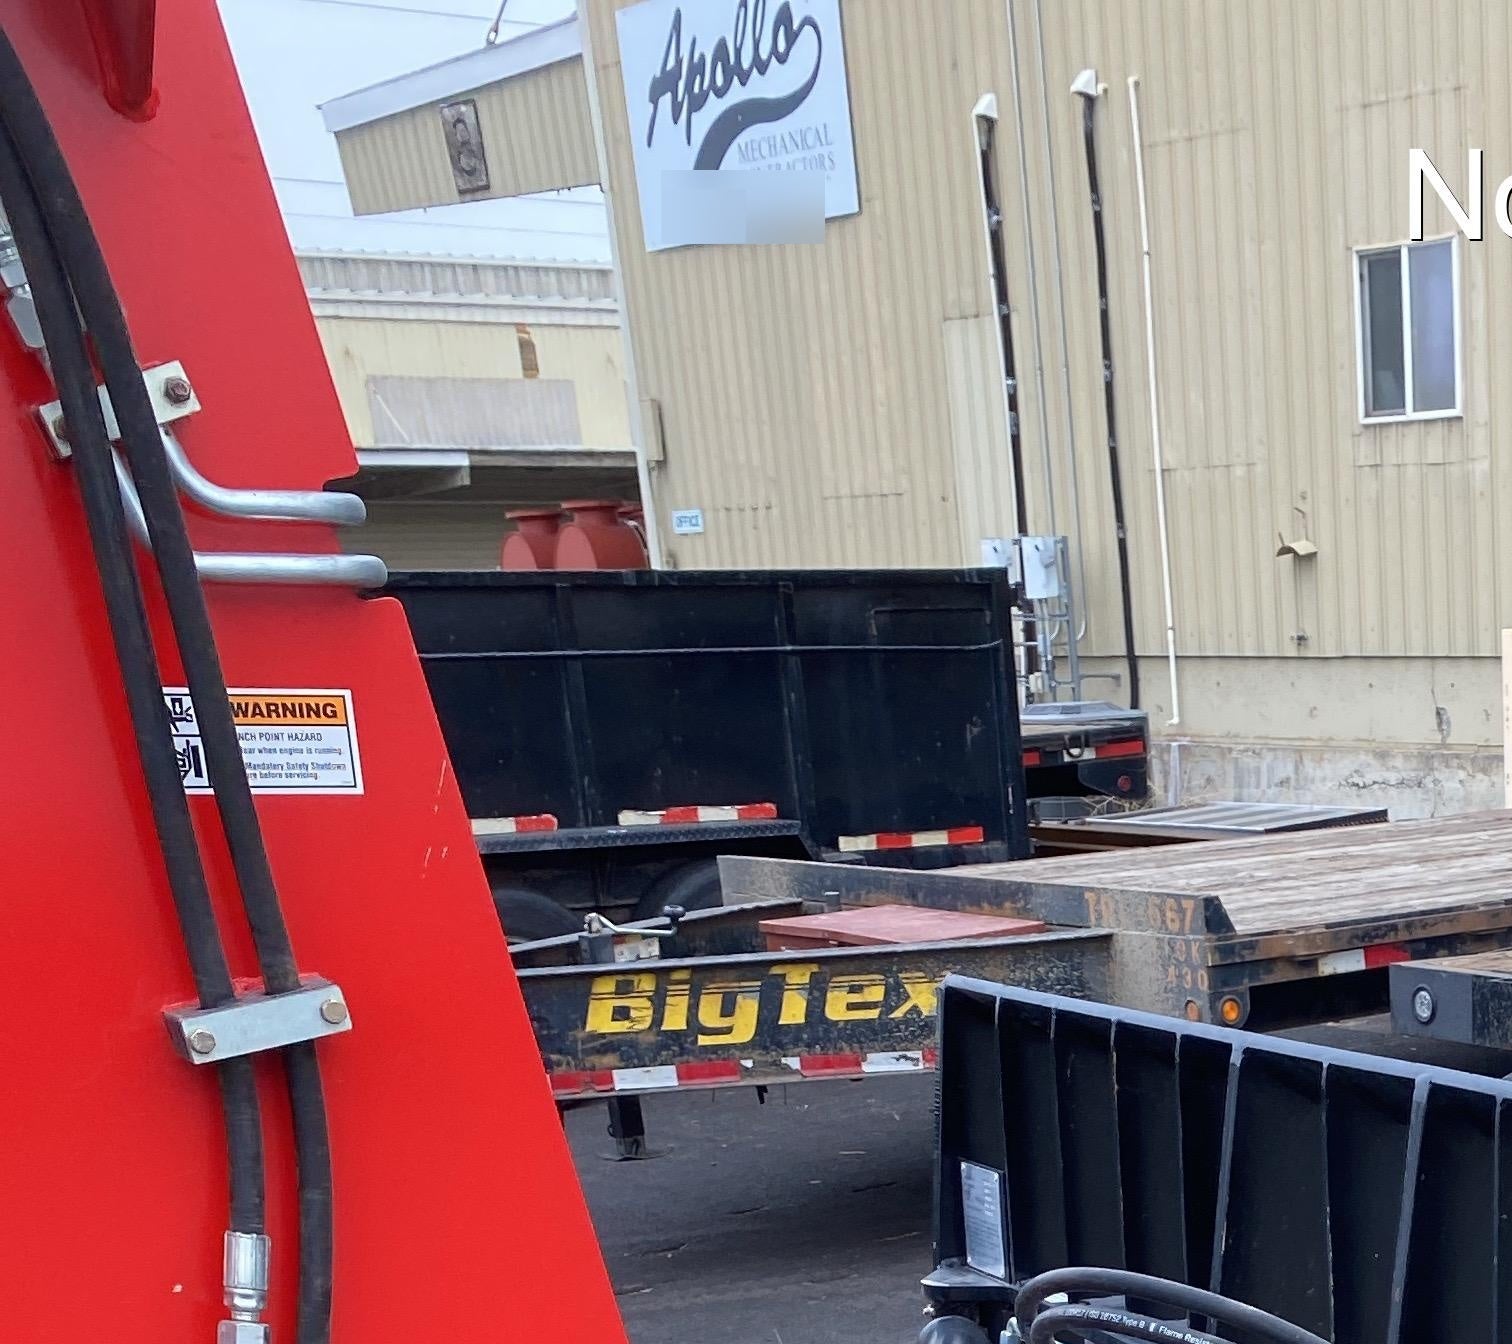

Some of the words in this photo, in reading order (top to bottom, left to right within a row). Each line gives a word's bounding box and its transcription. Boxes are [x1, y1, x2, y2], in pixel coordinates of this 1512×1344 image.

[646, 0, 806, 149] Apollo
[737, 122, 833, 164] MECHANICAL
[231, 701, 338, 719] WARNING
[237, 732, 257, 742] NCH
[259, 732, 285, 742] POINT
[287, 732, 323, 742] HAZARD
[1158, 1325, 1184, 1340] Flame
